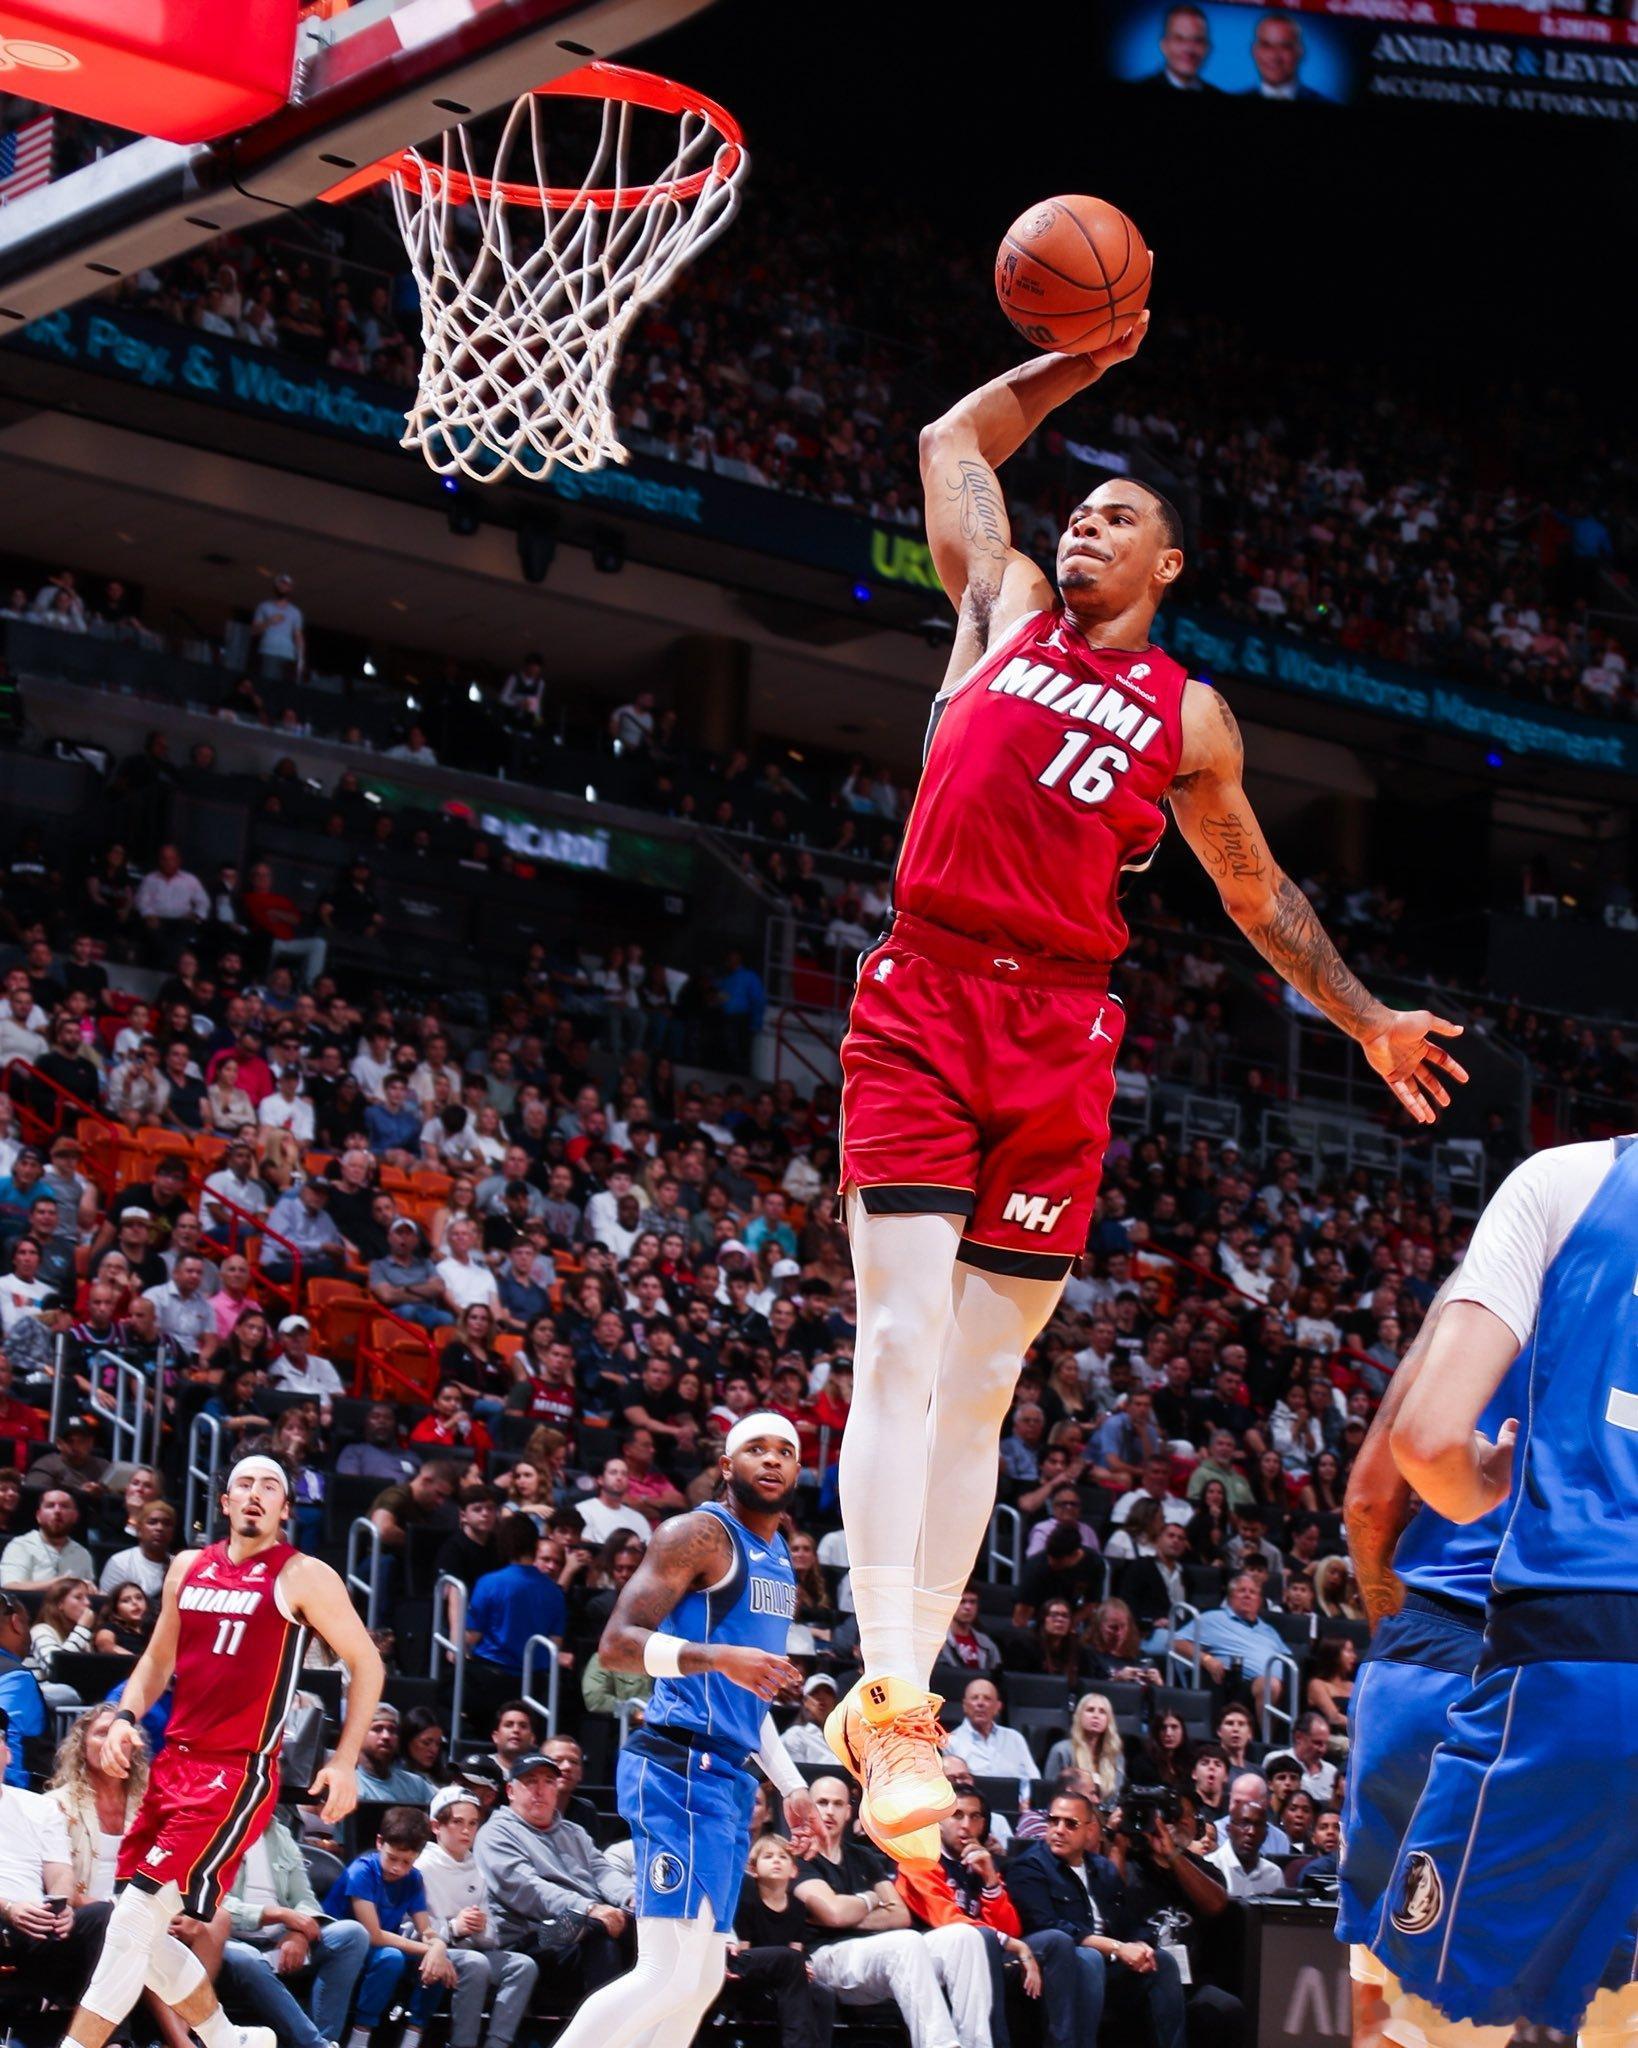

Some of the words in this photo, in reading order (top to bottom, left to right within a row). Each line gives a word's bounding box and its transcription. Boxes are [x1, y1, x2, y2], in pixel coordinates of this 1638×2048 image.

[181, 342, 221, 393] &
[986, 655, 1164, 754] MIAMI
[1115, 672, 1157, 705] Robinhood
[1036, 729, 1132, 805] 16
[177, 1584, 264, 1617] MIAMI
[211, 1618, 248, 1657] 11
